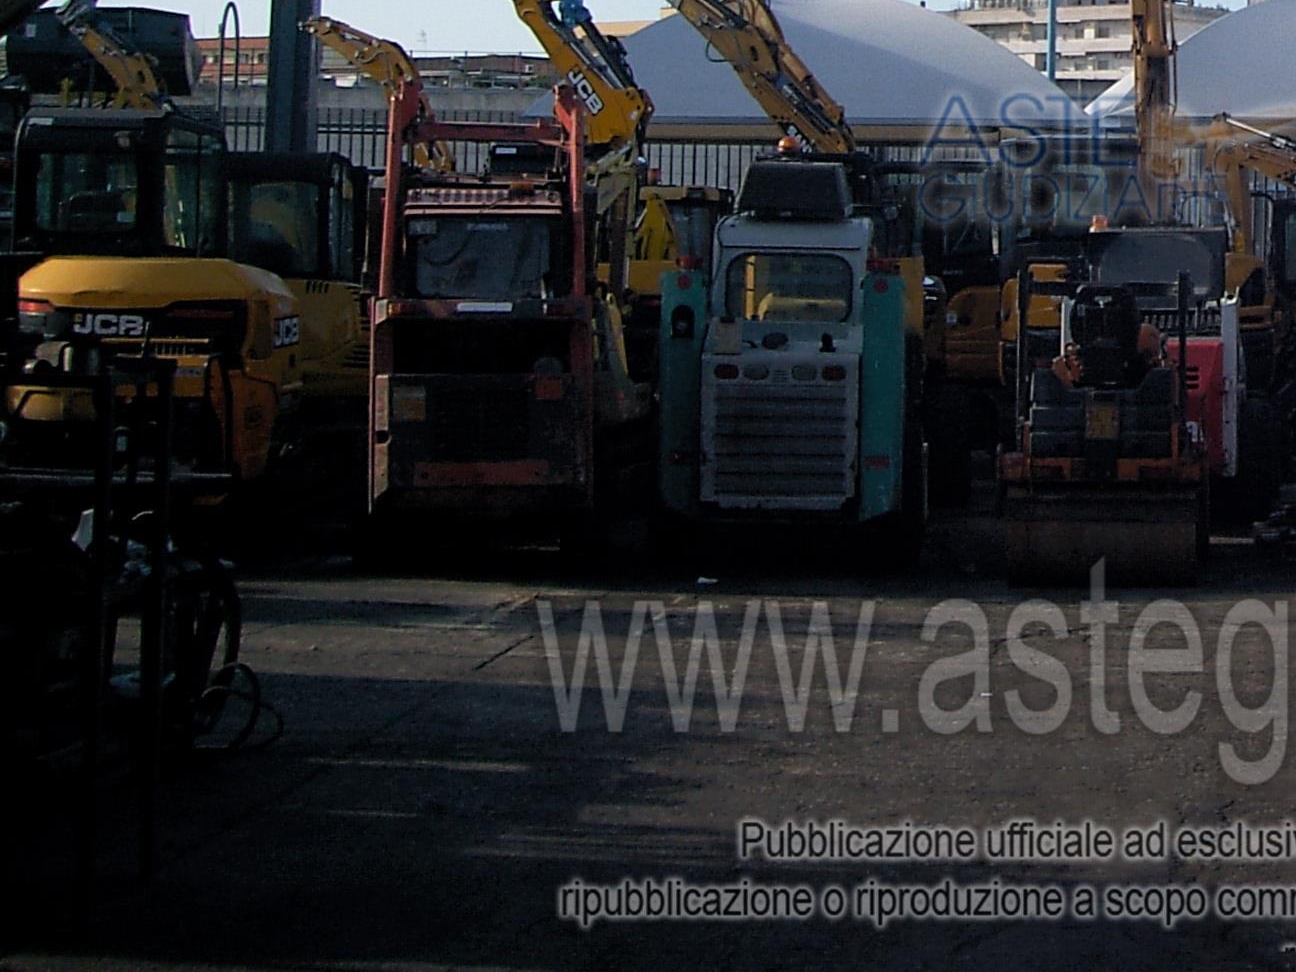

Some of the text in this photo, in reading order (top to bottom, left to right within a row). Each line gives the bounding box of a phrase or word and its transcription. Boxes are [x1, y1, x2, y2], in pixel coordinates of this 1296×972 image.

[568, 70, 604, 115] JCB
[73, 313, 144, 336] JCB
[272, 317, 300, 347] JCB
